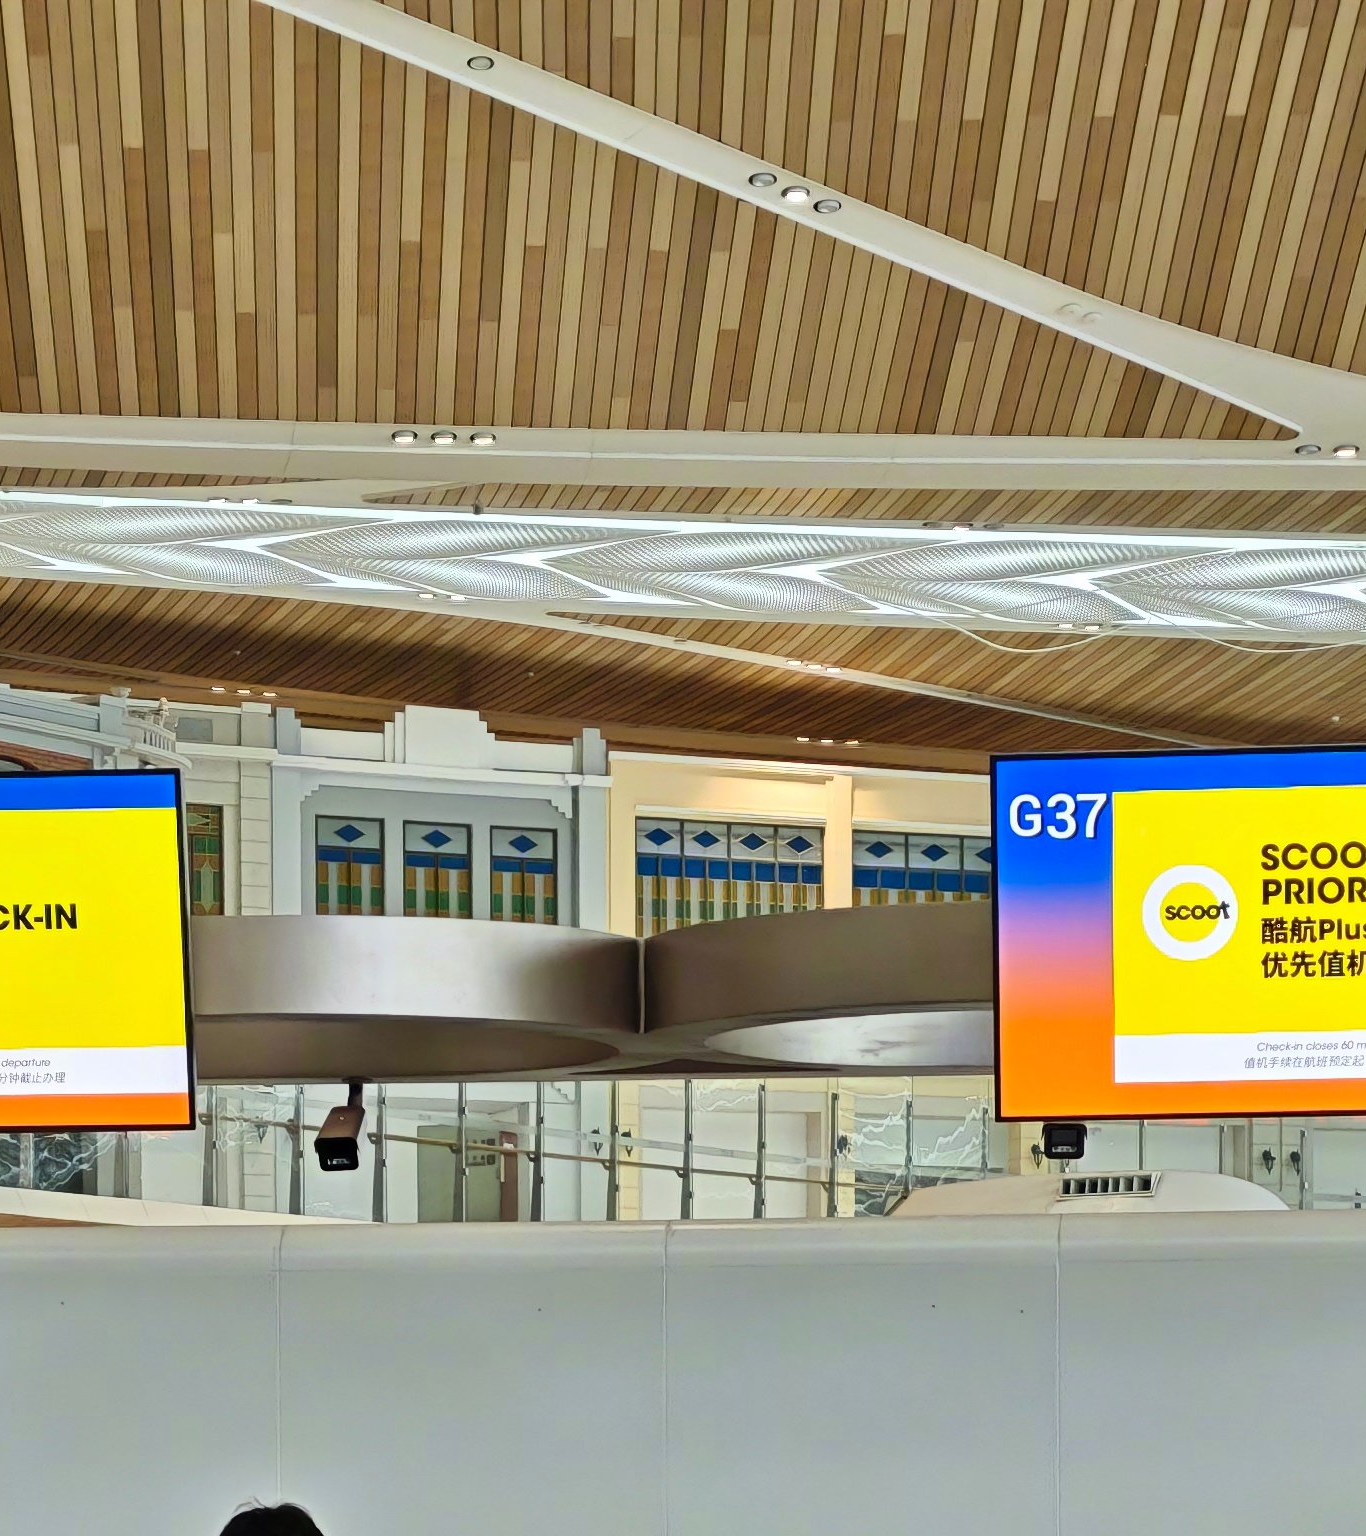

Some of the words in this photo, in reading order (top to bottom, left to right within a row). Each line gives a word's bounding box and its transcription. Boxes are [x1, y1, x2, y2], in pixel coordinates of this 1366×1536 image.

[1010, 794, 1106, 839] G37
[1165, 901, 1230, 922] scoot
[1256, 1041, 1303, 1052] Check-in
[1305, 1041, 1339, 1051] closes
[1341, 1040, 1354, 1050] 60
[1, 1058, 51, 1070] departure
